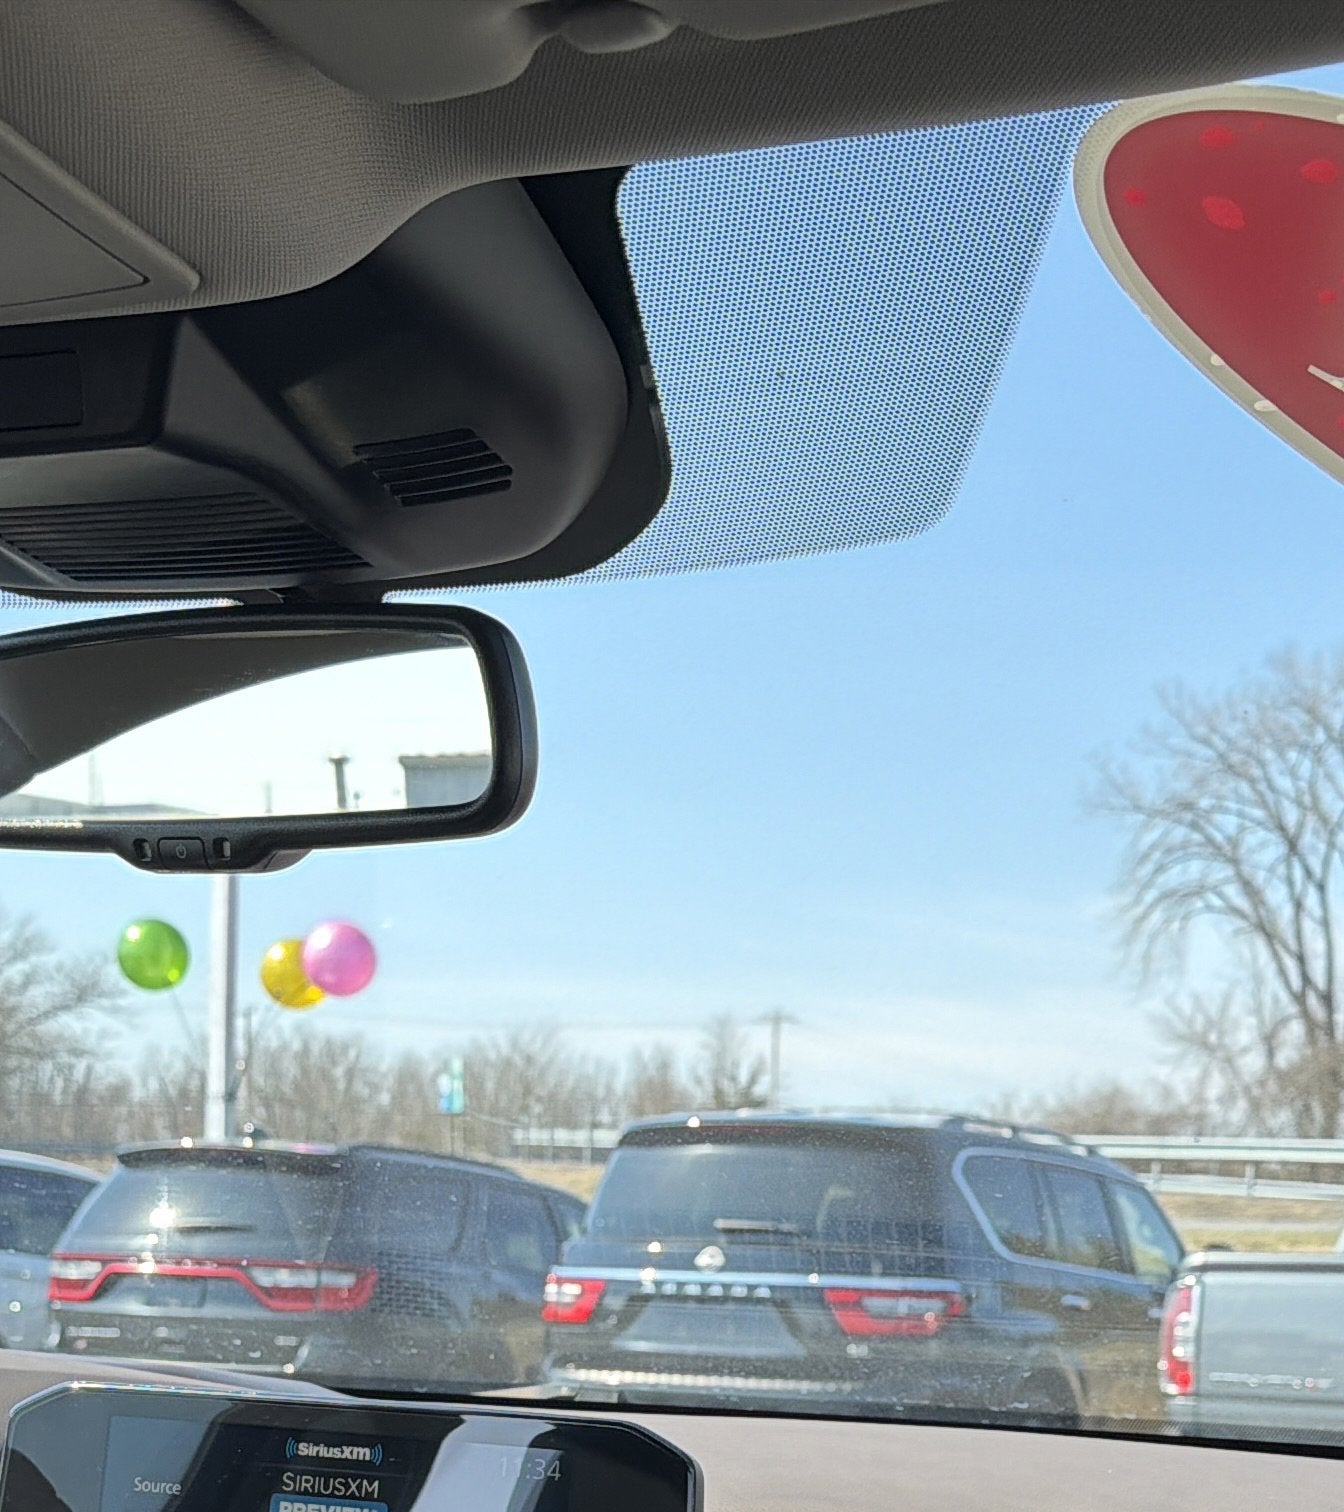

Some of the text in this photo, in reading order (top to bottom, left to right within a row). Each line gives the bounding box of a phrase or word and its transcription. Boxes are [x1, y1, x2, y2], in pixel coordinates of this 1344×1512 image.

[500, 1457, 562, 1481] 11:34
[133, 1476, 182, 1495] Source
[281, 1471, 380, 1499] SIRIUSXM
